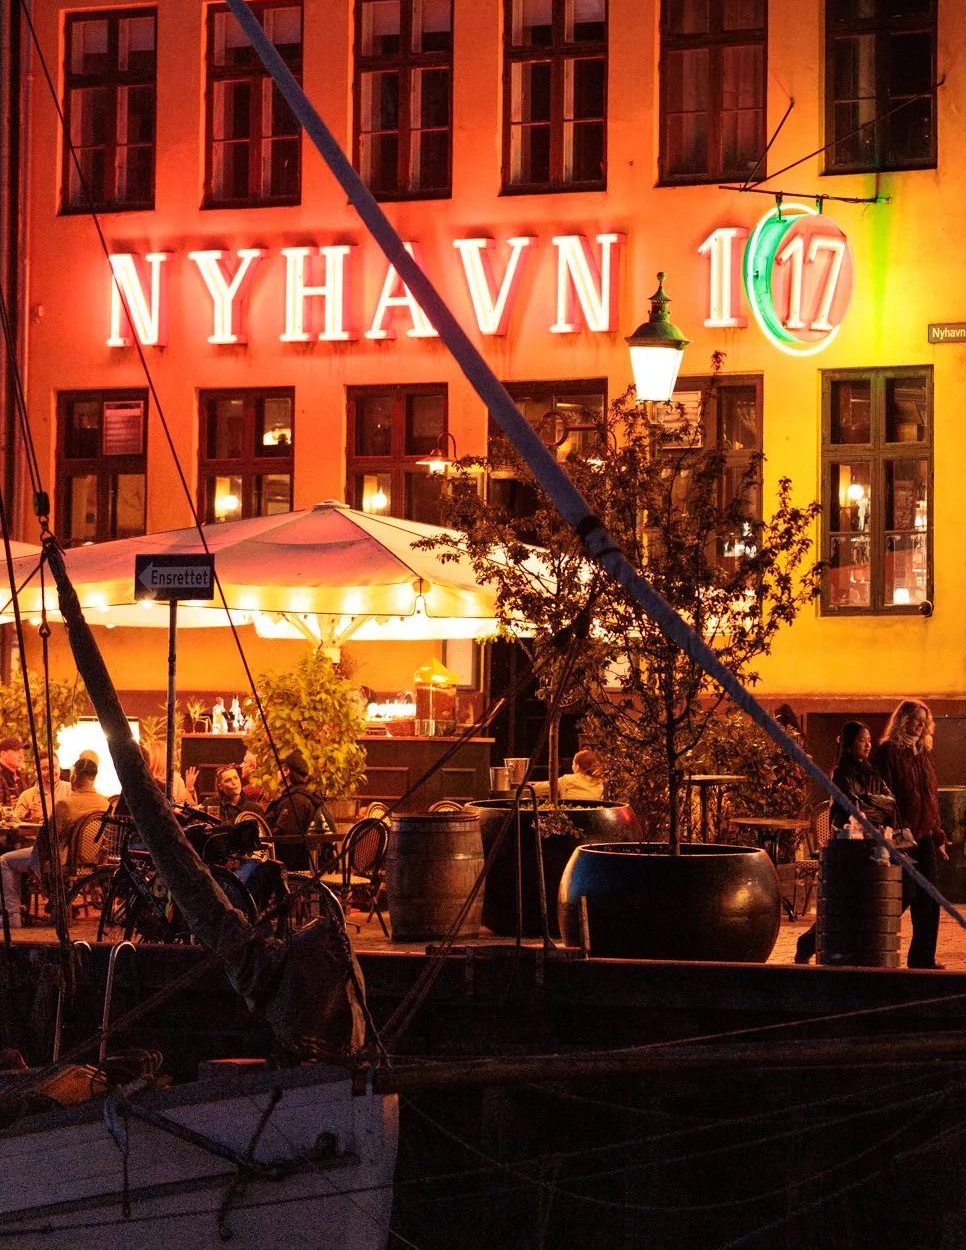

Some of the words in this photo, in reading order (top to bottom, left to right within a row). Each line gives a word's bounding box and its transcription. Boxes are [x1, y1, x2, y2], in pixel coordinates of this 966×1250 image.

[106, 234, 622, 347] NYHAVN
[697, 227, 747, 328] 1
[775, 236, 846, 331] 17
[932, 327, 966, 340] Nyhavn
[151, 570, 208, 585] Ensrettet
